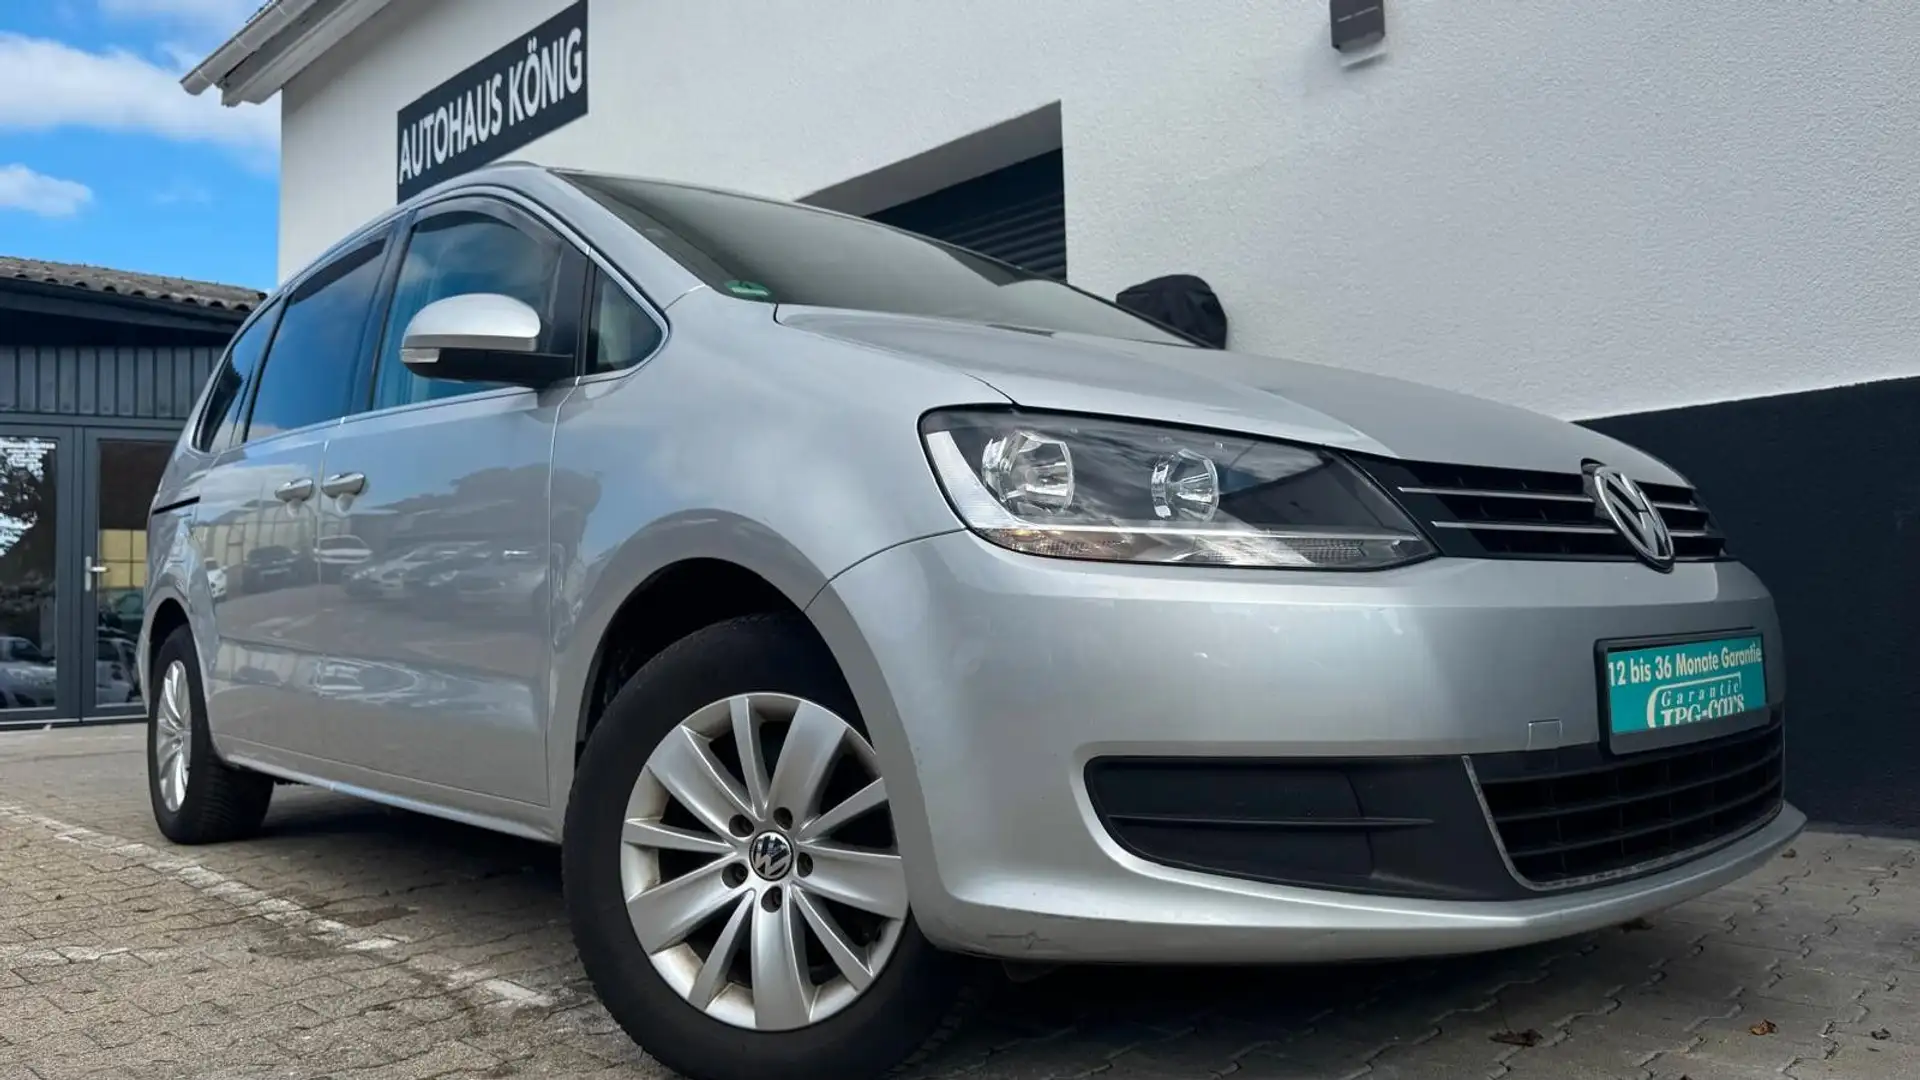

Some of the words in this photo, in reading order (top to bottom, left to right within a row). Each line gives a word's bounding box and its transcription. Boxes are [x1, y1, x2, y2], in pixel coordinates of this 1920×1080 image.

[399, 73, 503, 185] AUTOHAUS
[508, 27, 582, 126] KÖNIG
[1608, 661, 1627, 687] 12
[1630, 656, 1652, 684] bis
[1655, 655, 1672, 680] 36
[1675, 652, 1720, 677] Monate
[1720, 643, 1763, 668] Garantie
[1661, 680, 1740, 707] Garantie
